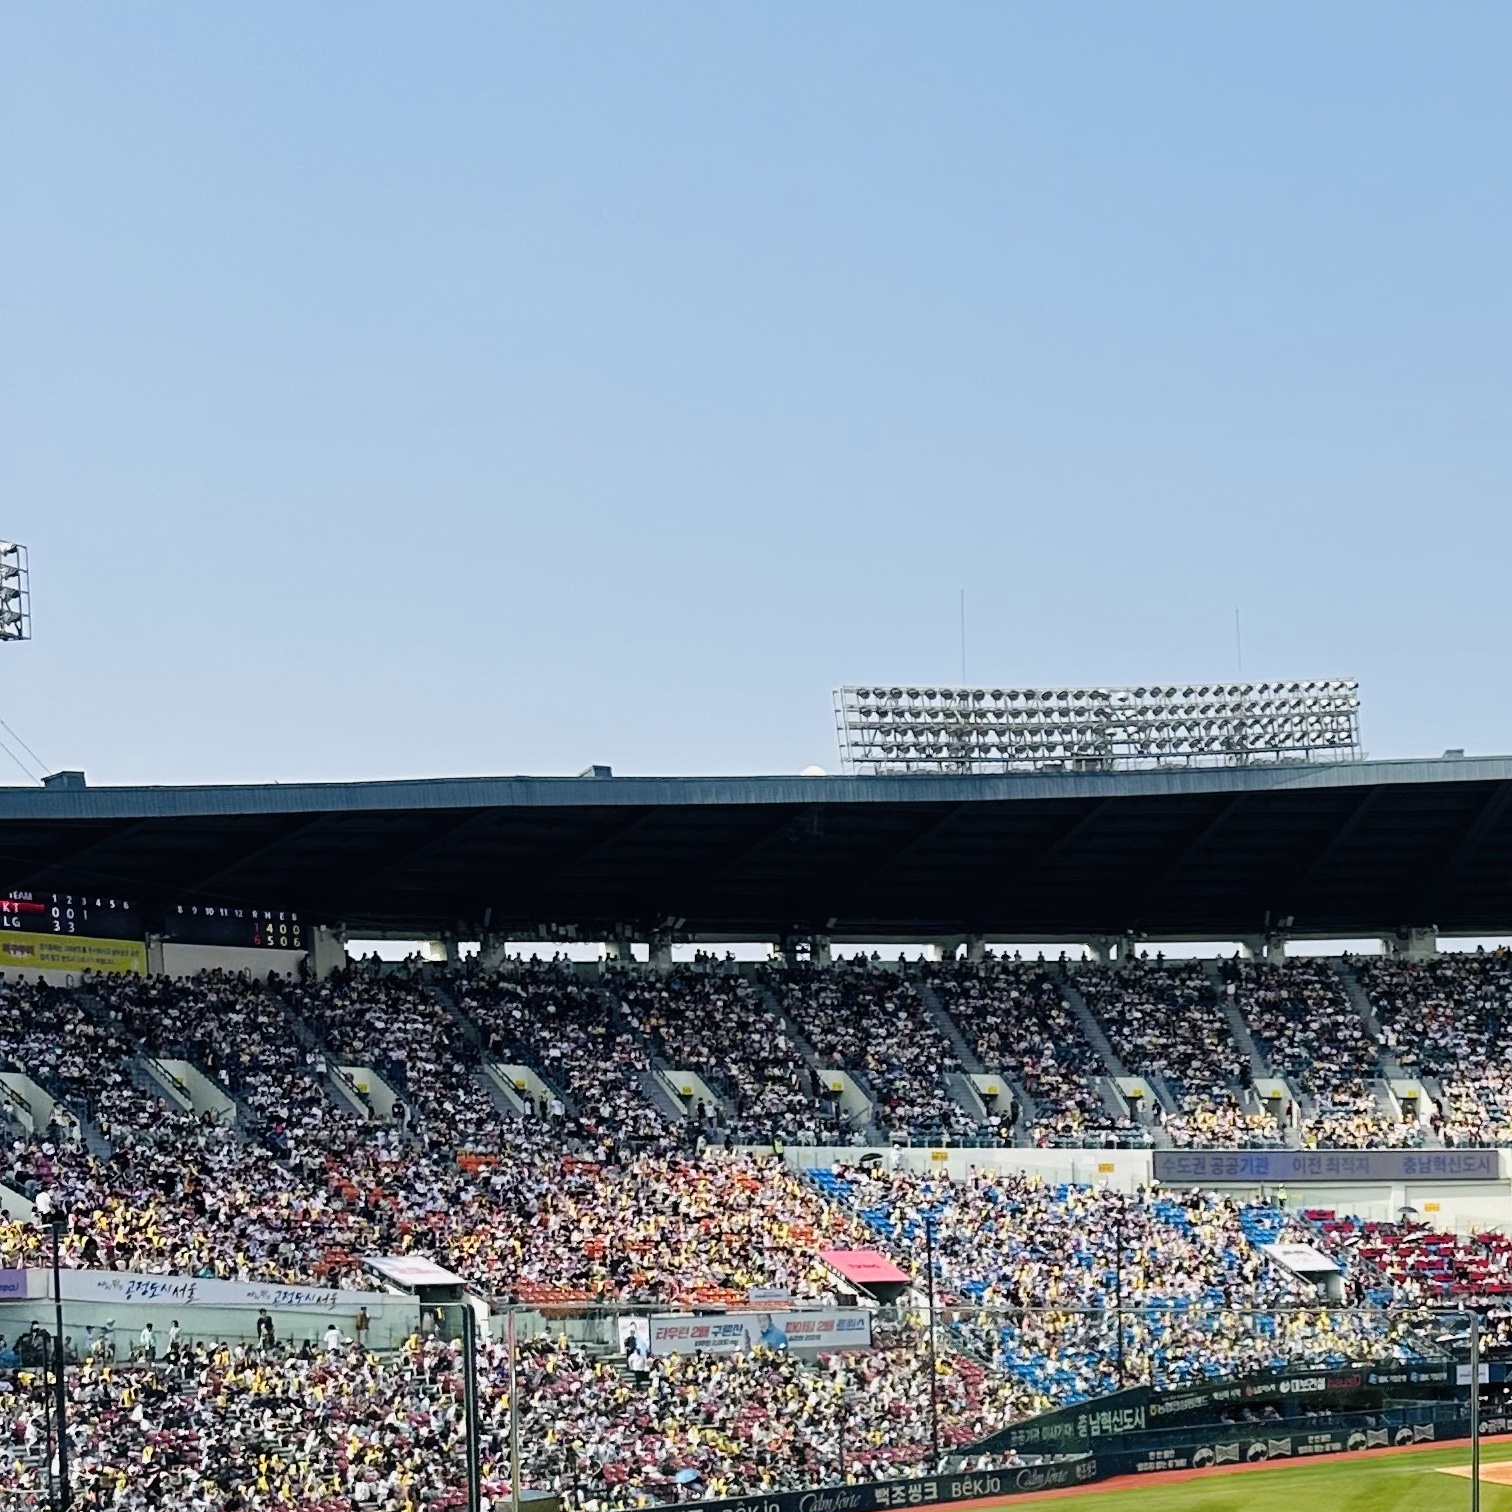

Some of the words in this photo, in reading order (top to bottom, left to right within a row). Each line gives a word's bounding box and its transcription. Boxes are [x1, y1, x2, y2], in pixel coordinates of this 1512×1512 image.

[52, 893, 58, 903] 1
[66, 895, 73, 905] 2
[3, 915, 21, 928] LG
[53, 920, 61, 932] 3
[68, 921, 75, 933] 3
[266, 923, 274, 934] 4
[1162, 1157, 1207, 1175] 수도권
[1210, 1156, 1269, 1175] 공공기관
[1292, 1155, 1322, 1175] 이전
[1326, 1155, 1370, 1174] 최적지
[1403, 1154, 1490, 1175] 충남혁신도시
[874, 1481, 938, 1506] 백조씽크
